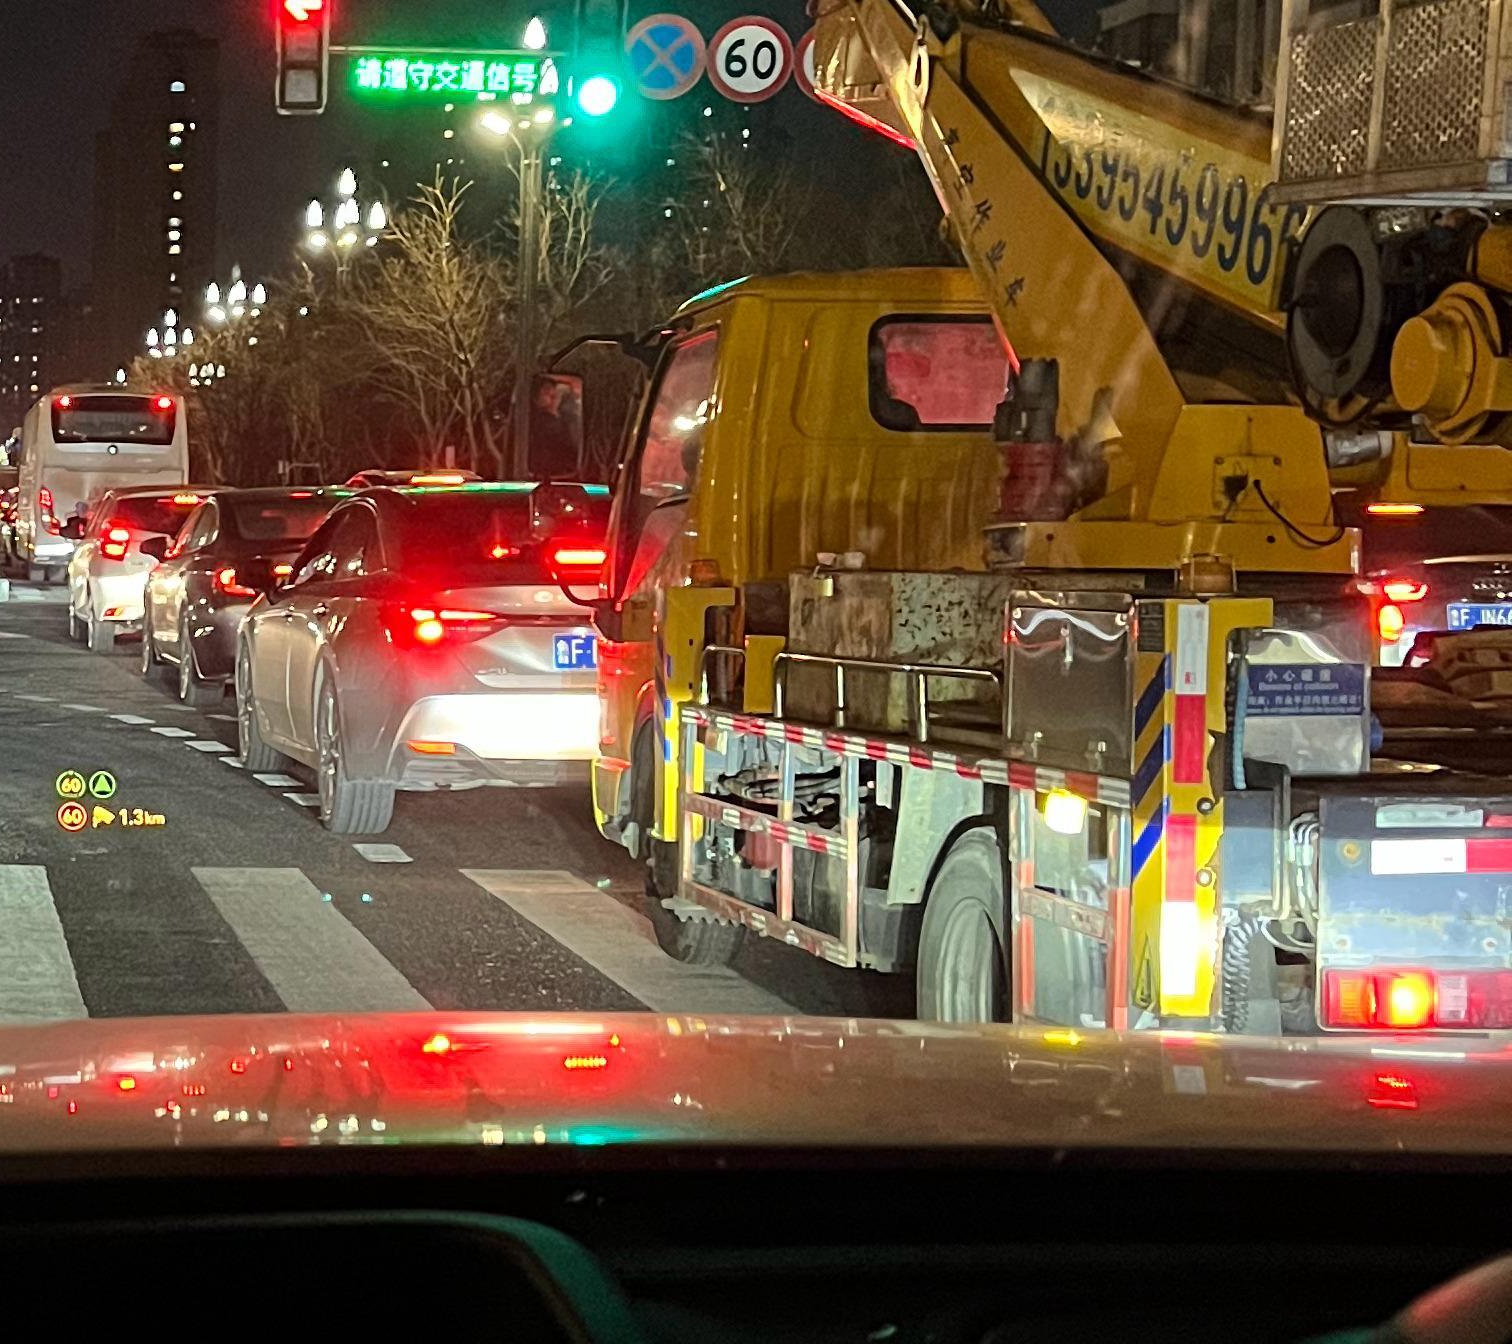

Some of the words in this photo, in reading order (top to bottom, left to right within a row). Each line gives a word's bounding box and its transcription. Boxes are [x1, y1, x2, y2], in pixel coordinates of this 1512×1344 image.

[724, 38, 777, 80] 60
[60, 777, 80, 794] 60
[62, 808, 83, 825] 60
